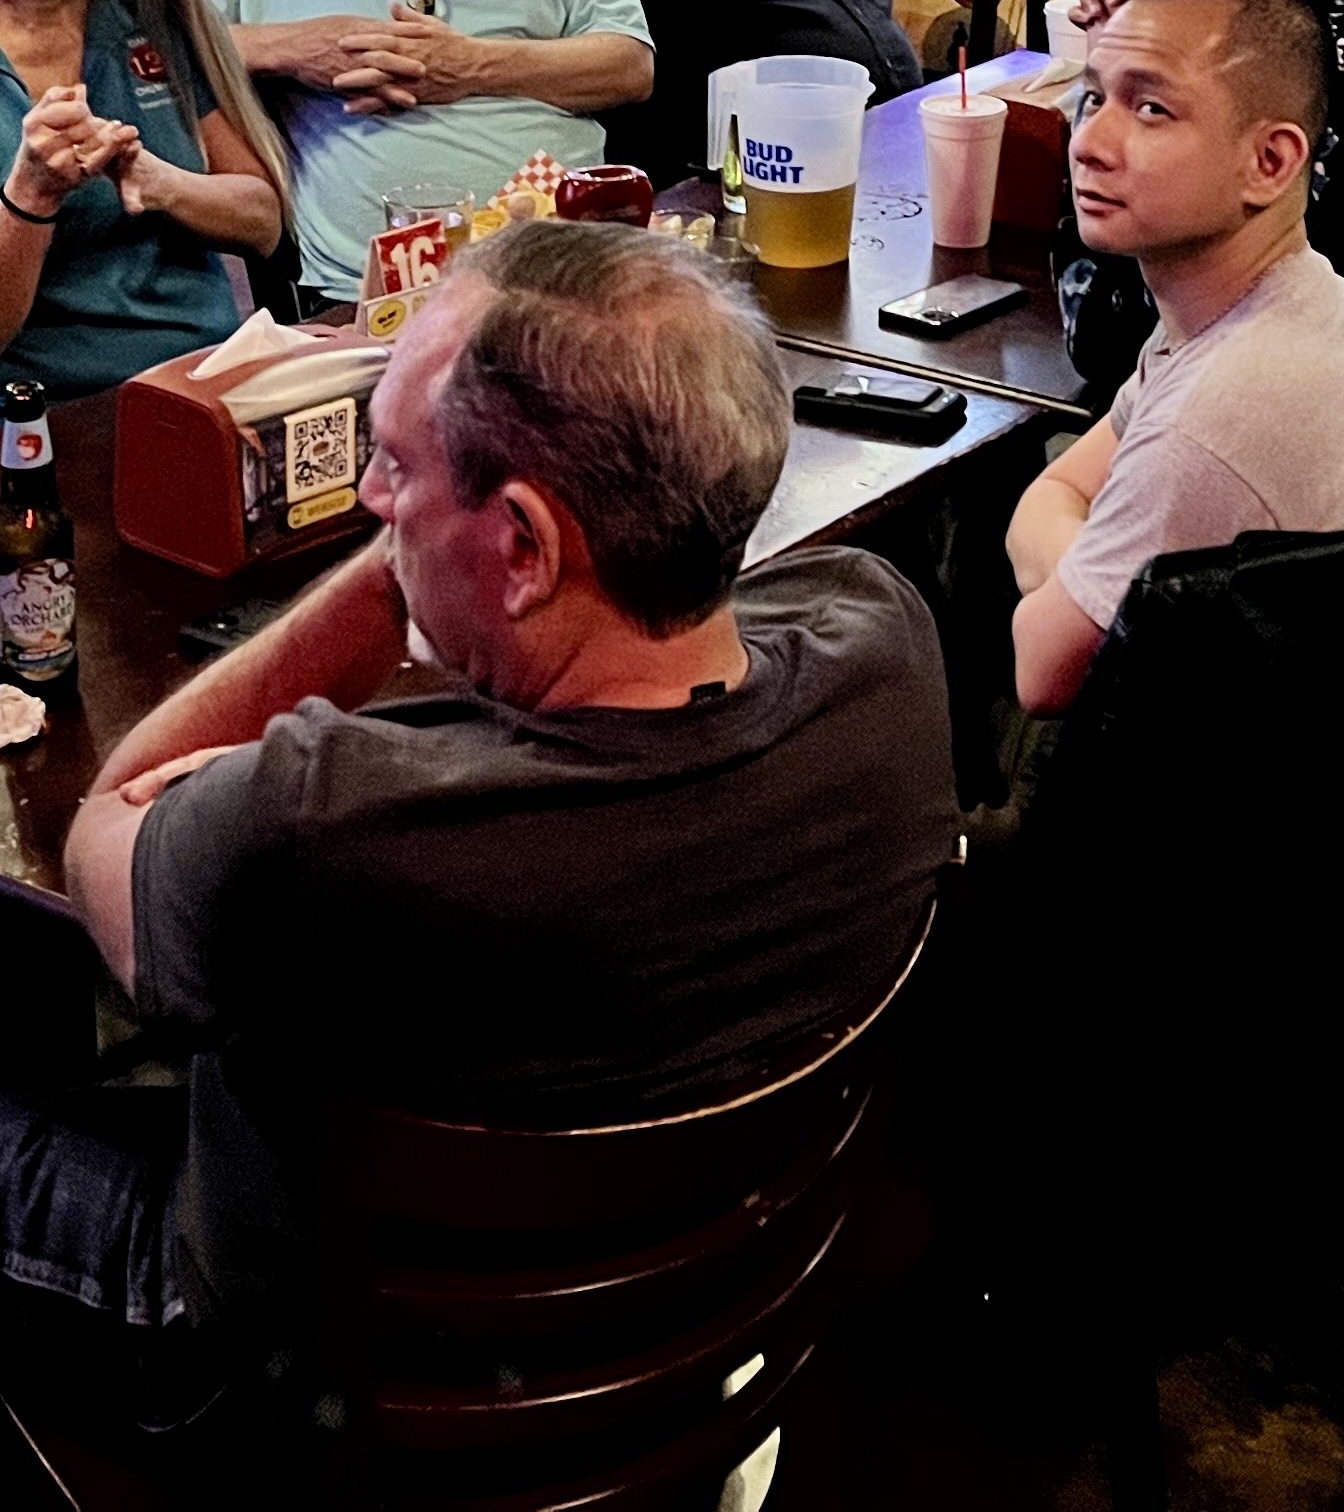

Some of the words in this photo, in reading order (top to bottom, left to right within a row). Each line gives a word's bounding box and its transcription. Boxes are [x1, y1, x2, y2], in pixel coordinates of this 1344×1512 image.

[746, 138, 793, 163] BUD
[743, 155, 804, 184] LIGHT
[390, 236, 439, 289] 16
